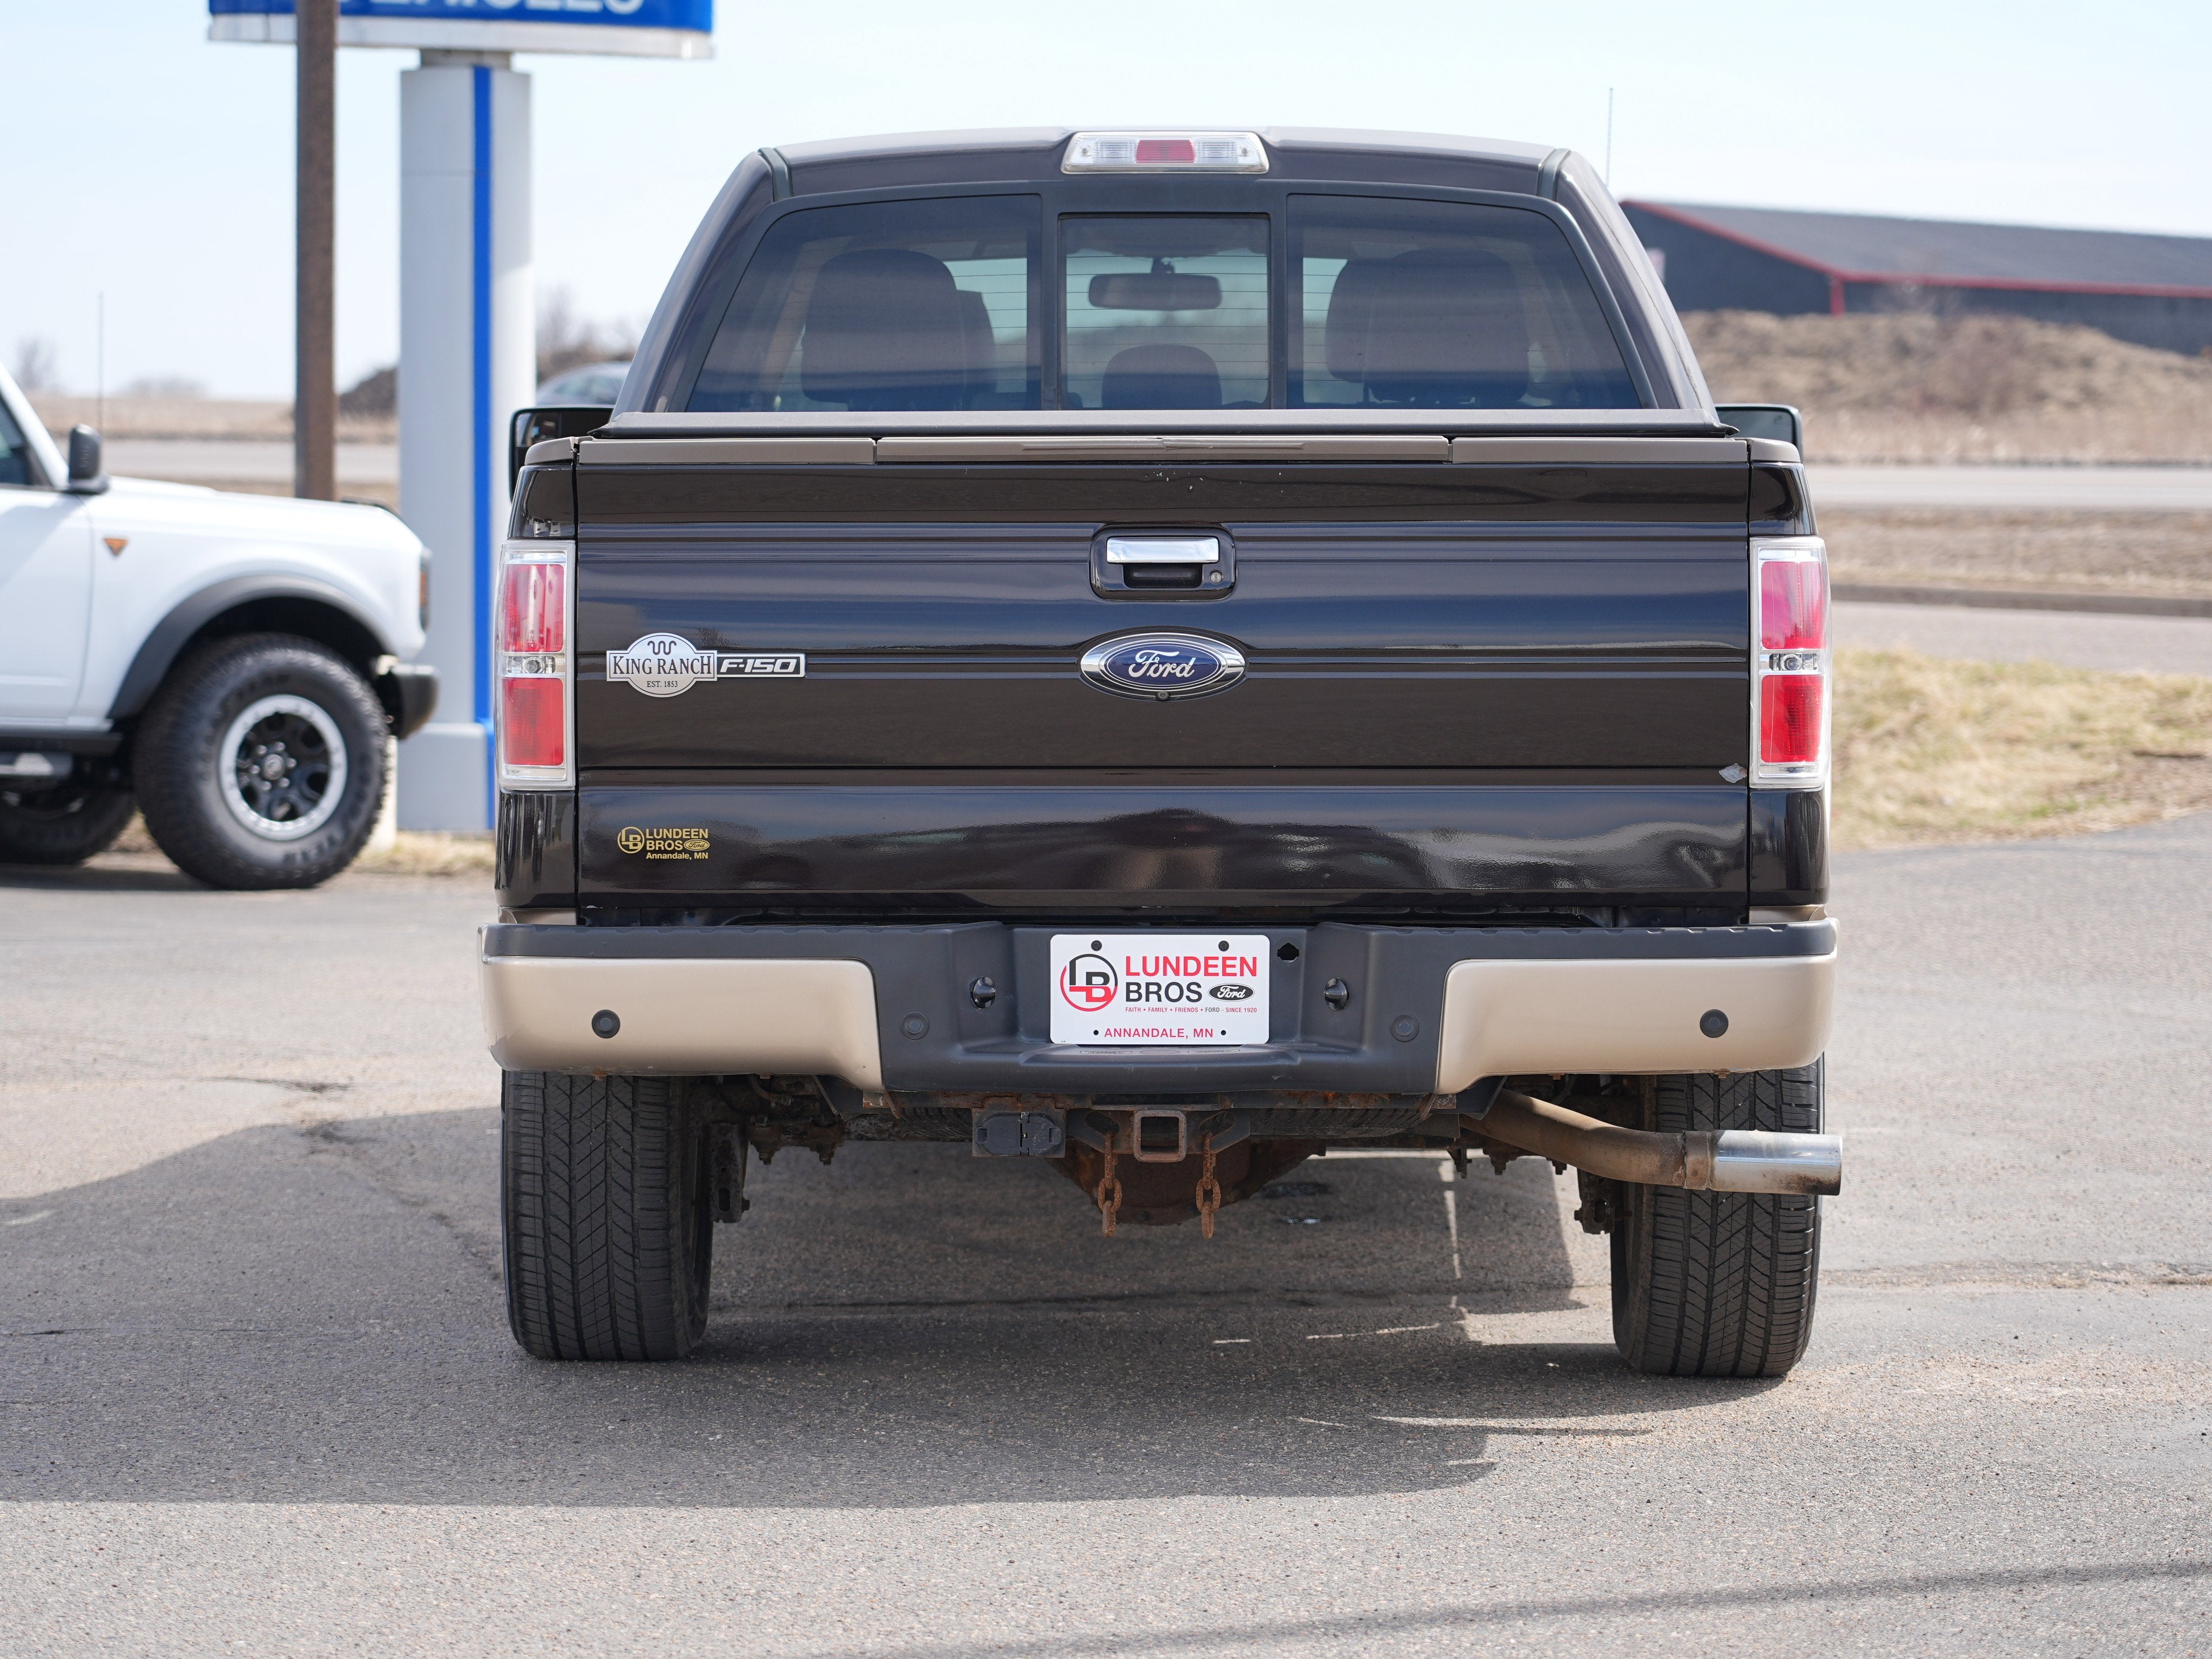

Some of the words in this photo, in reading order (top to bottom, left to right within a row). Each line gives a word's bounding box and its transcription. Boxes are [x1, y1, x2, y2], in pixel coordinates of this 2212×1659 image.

[612, 656, 652, 675] KING
[657, 655, 712, 675] RANCH
[720, 658, 798, 673] F-150
[1128, 649, 1197, 678] Ford
[646, 828, 709, 839] LUNDEEN
[646, 840, 683, 851] BROS
[646, 852, 692, 860] Annandale,
[1125, 956, 1257, 977] LUNDEEN
[1125, 981, 1203, 1003] BROS
[1217, 985, 1246, 999] Ford
[1104, 1028, 1188, 1040] ANNANDALE,
[1193, 1028, 1214, 1038] MN
